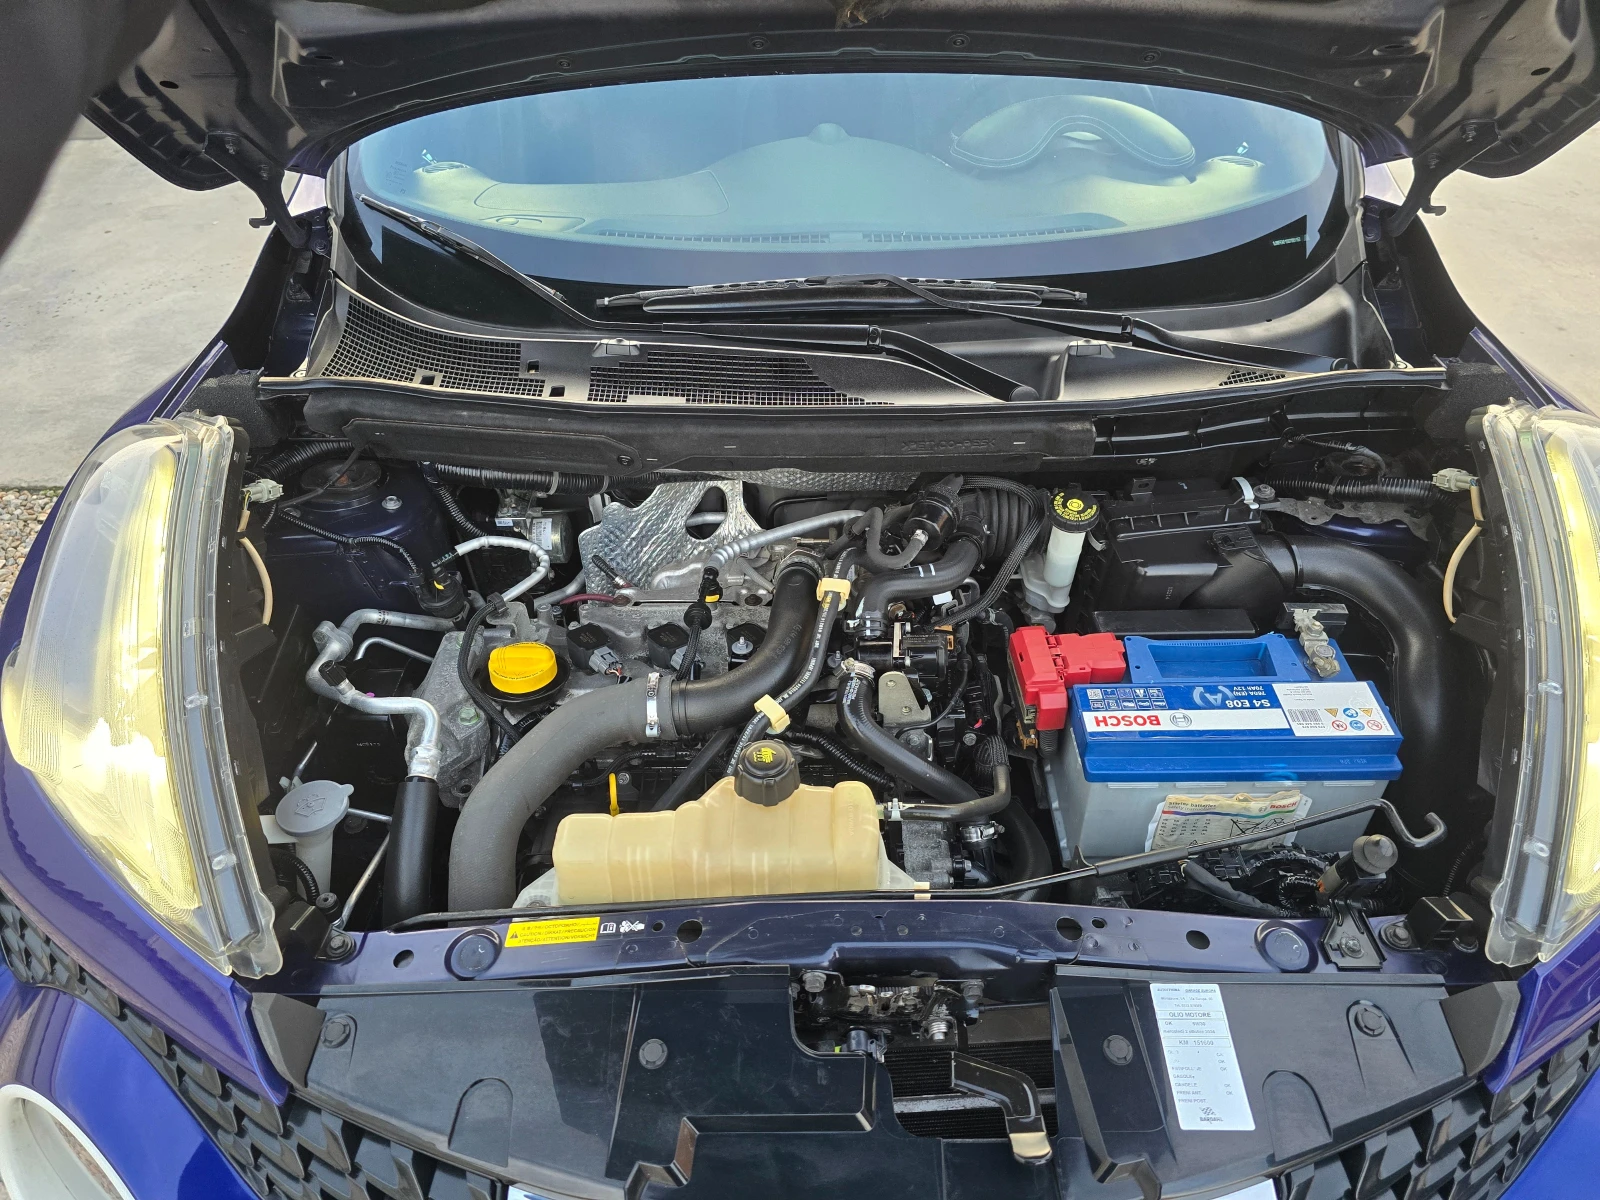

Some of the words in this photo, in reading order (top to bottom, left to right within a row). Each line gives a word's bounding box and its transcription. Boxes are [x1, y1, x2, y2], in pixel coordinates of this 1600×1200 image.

[1225, 699, 1250, 708] E08
[1252, 699, 1271, 707] S4
[1093, 714, 1161, 727] BOSCH
[1269, 801, 1297, 810] BOSCH
